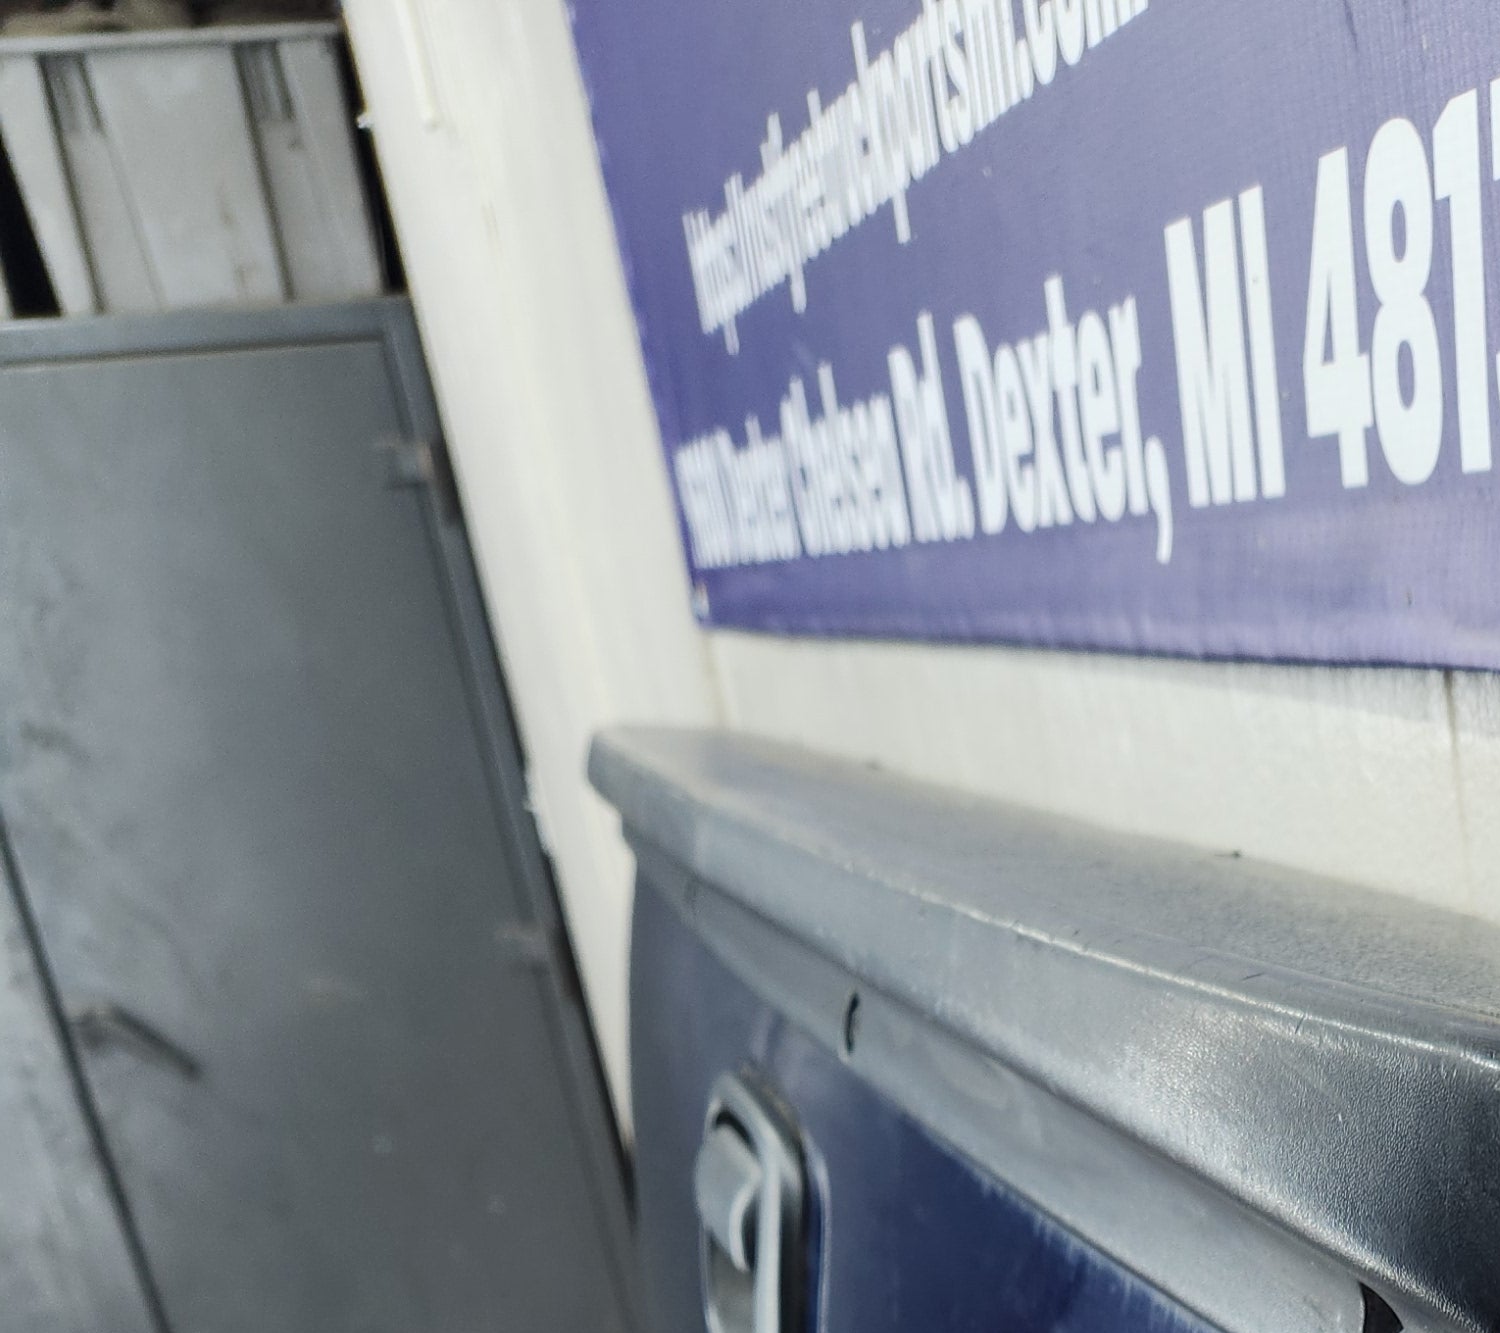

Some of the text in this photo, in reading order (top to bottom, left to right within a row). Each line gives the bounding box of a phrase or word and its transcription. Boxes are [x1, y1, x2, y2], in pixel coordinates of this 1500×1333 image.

[888, 309, 976, 544] Rd.
[953, 273, 1173, 564] Dexter,
[1164, 184, 1286, 508] MI
